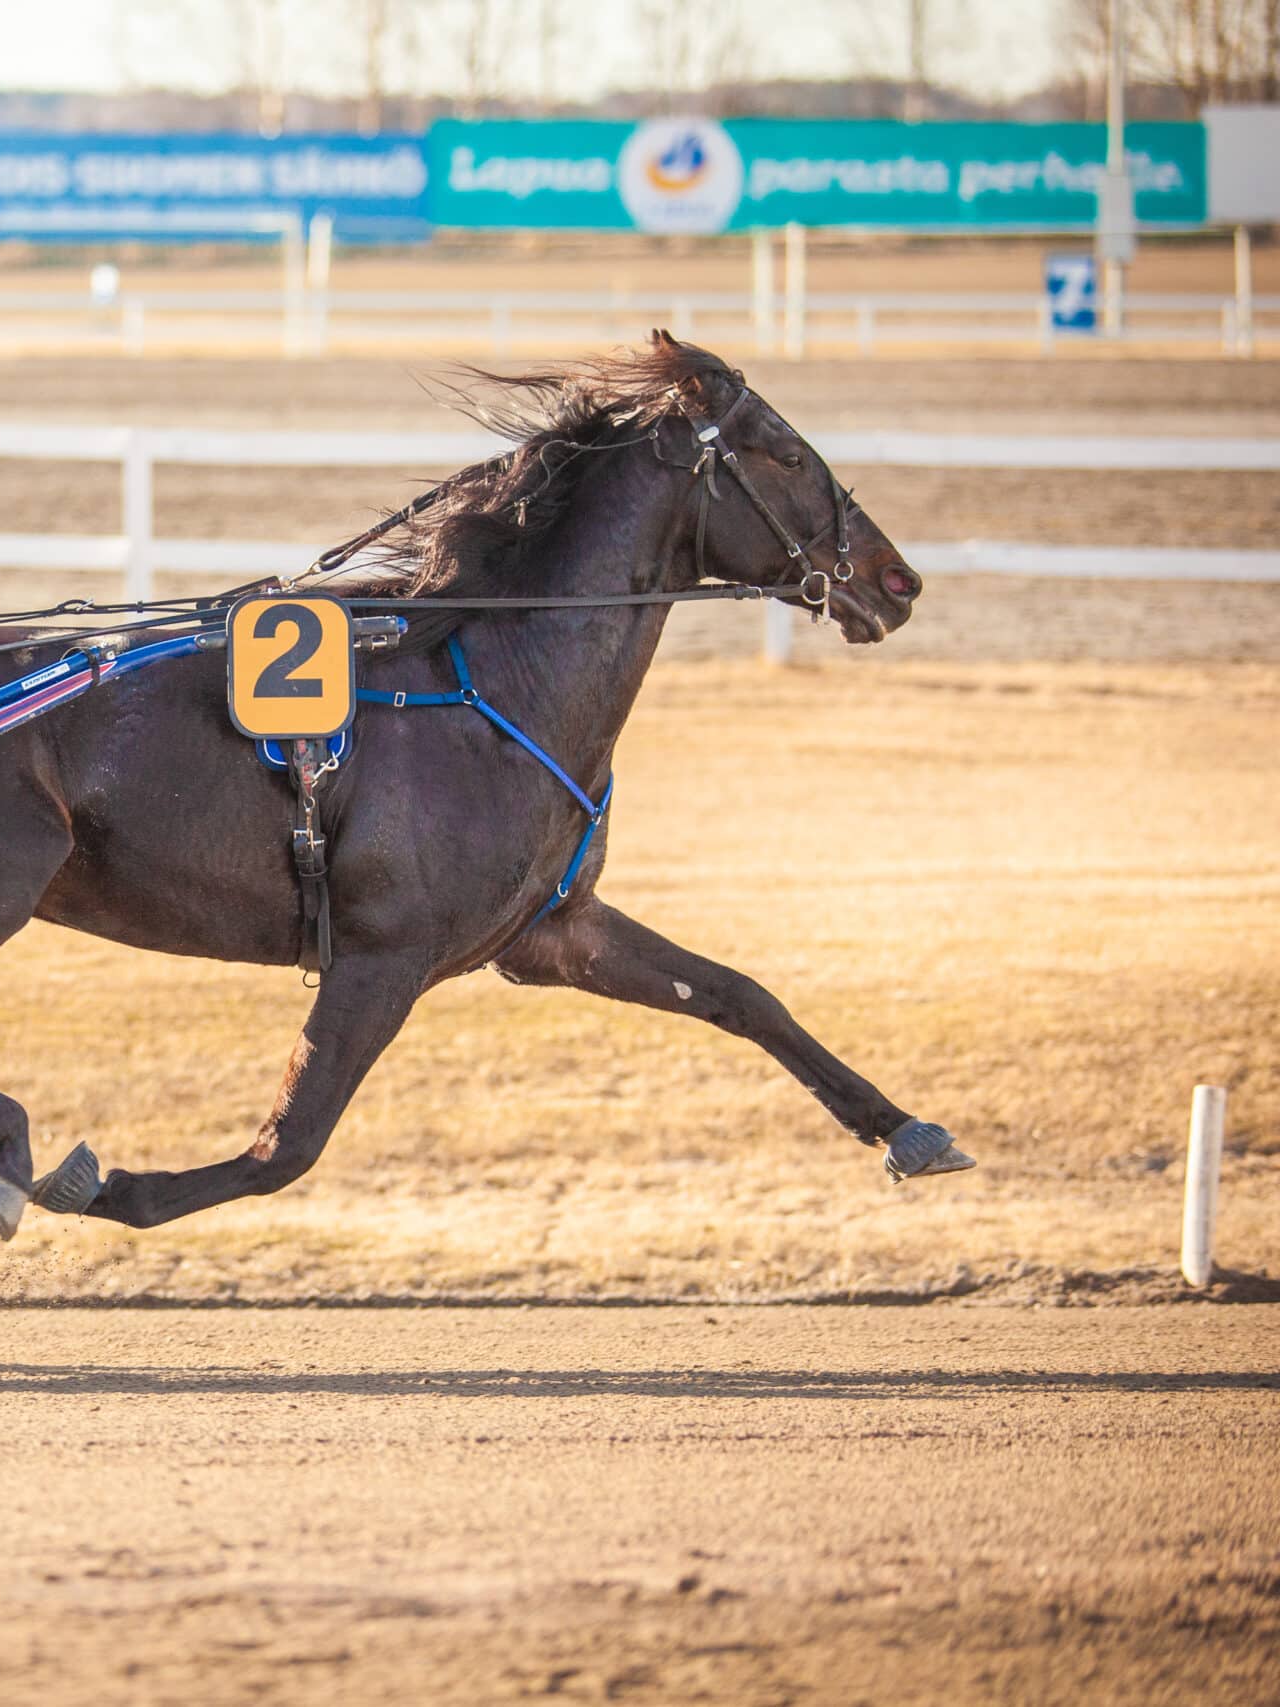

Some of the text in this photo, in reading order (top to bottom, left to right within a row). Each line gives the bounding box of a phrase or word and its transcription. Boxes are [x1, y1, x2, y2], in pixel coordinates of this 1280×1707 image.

[449, 146, 1184, 202] Lapua parasta perhelle
[252, 604, 324, 698] 2
